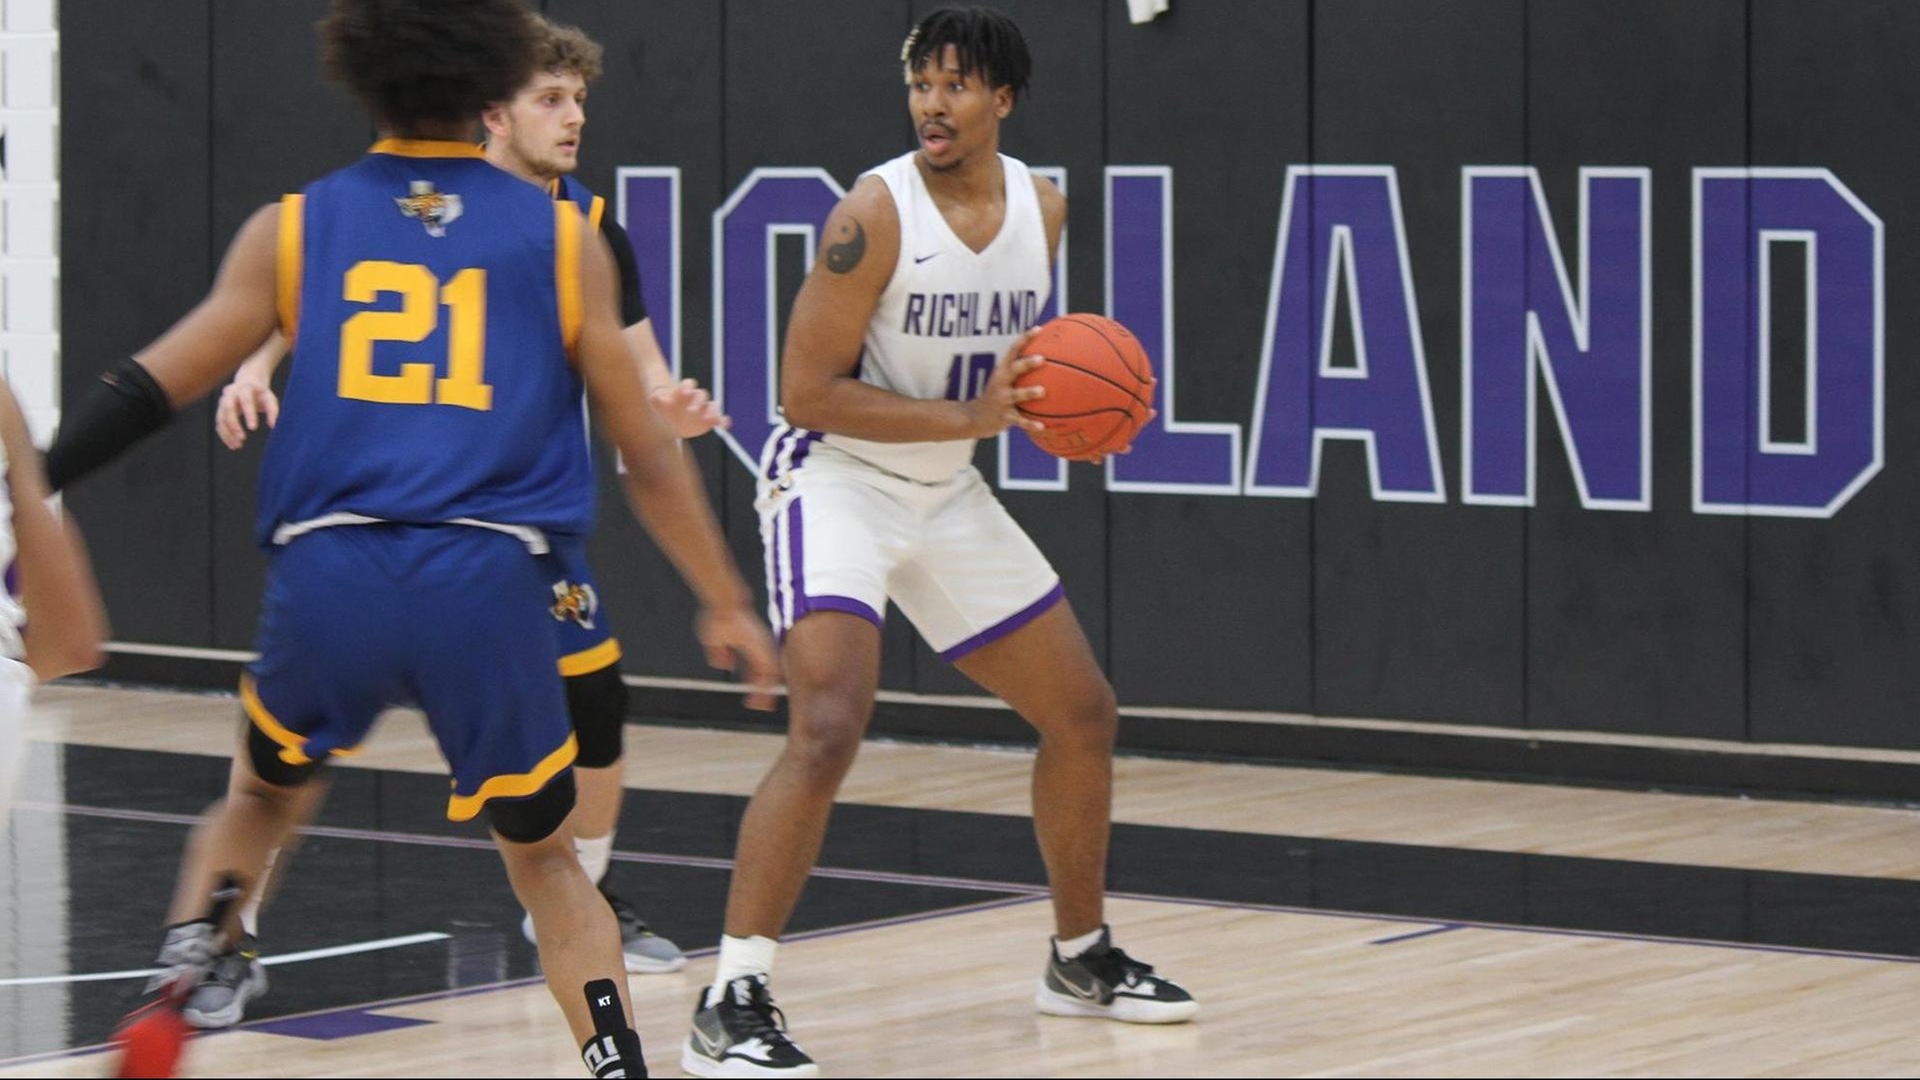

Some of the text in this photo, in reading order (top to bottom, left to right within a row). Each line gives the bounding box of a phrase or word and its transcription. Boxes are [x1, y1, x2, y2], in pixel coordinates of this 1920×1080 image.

[337, 260, 493, 411] 21
[903, 290, 1038, 337] RICHLAND
[597, 995, 611, 1007] KT
